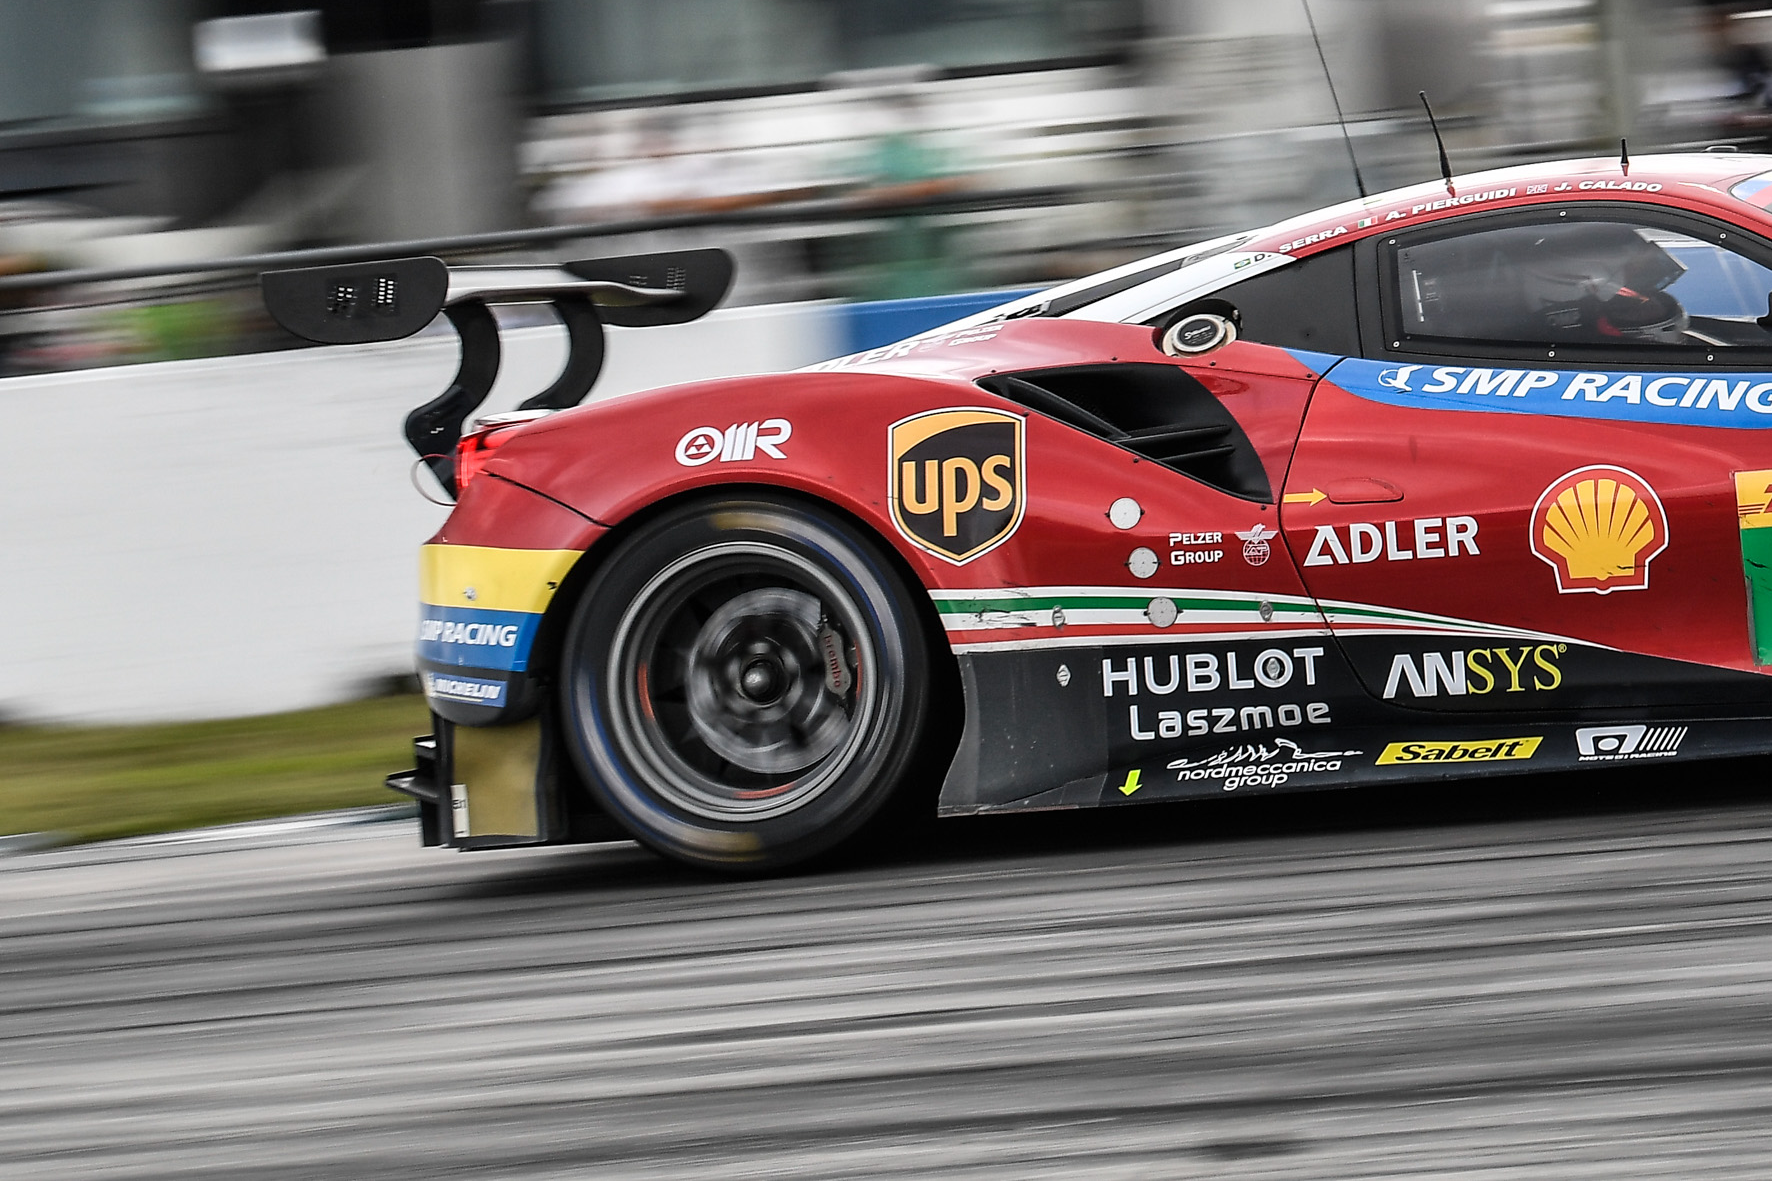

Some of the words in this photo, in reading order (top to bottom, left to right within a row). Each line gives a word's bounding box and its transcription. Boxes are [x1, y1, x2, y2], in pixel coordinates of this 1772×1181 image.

[1553, 181, 1573, 192] J.
[1578, 180, 1663, 193] CALADO
[1385, 210, 1407, 222] A.
[1411, 187, 1517, 215] PIERGUIDI
[1253, 252, 1272, 263] D.
[1278, 225, 1348, 254] SERRA
[1422, 365, 1560, 399] SMP
[902, 454, 1014, 537] ups
[1302, 515, 1481, 568] ADLER
[441, 621, 519, 647] RACING
[824, 635, 842, 688] brembo
[1101, 646, 1325, 698] HUBLOT
[1394, 739, 1526, 762] Sabelt
[1177, 758, 1342, 782] nordmeccanica
[1222, 772, 1289, 792] group
